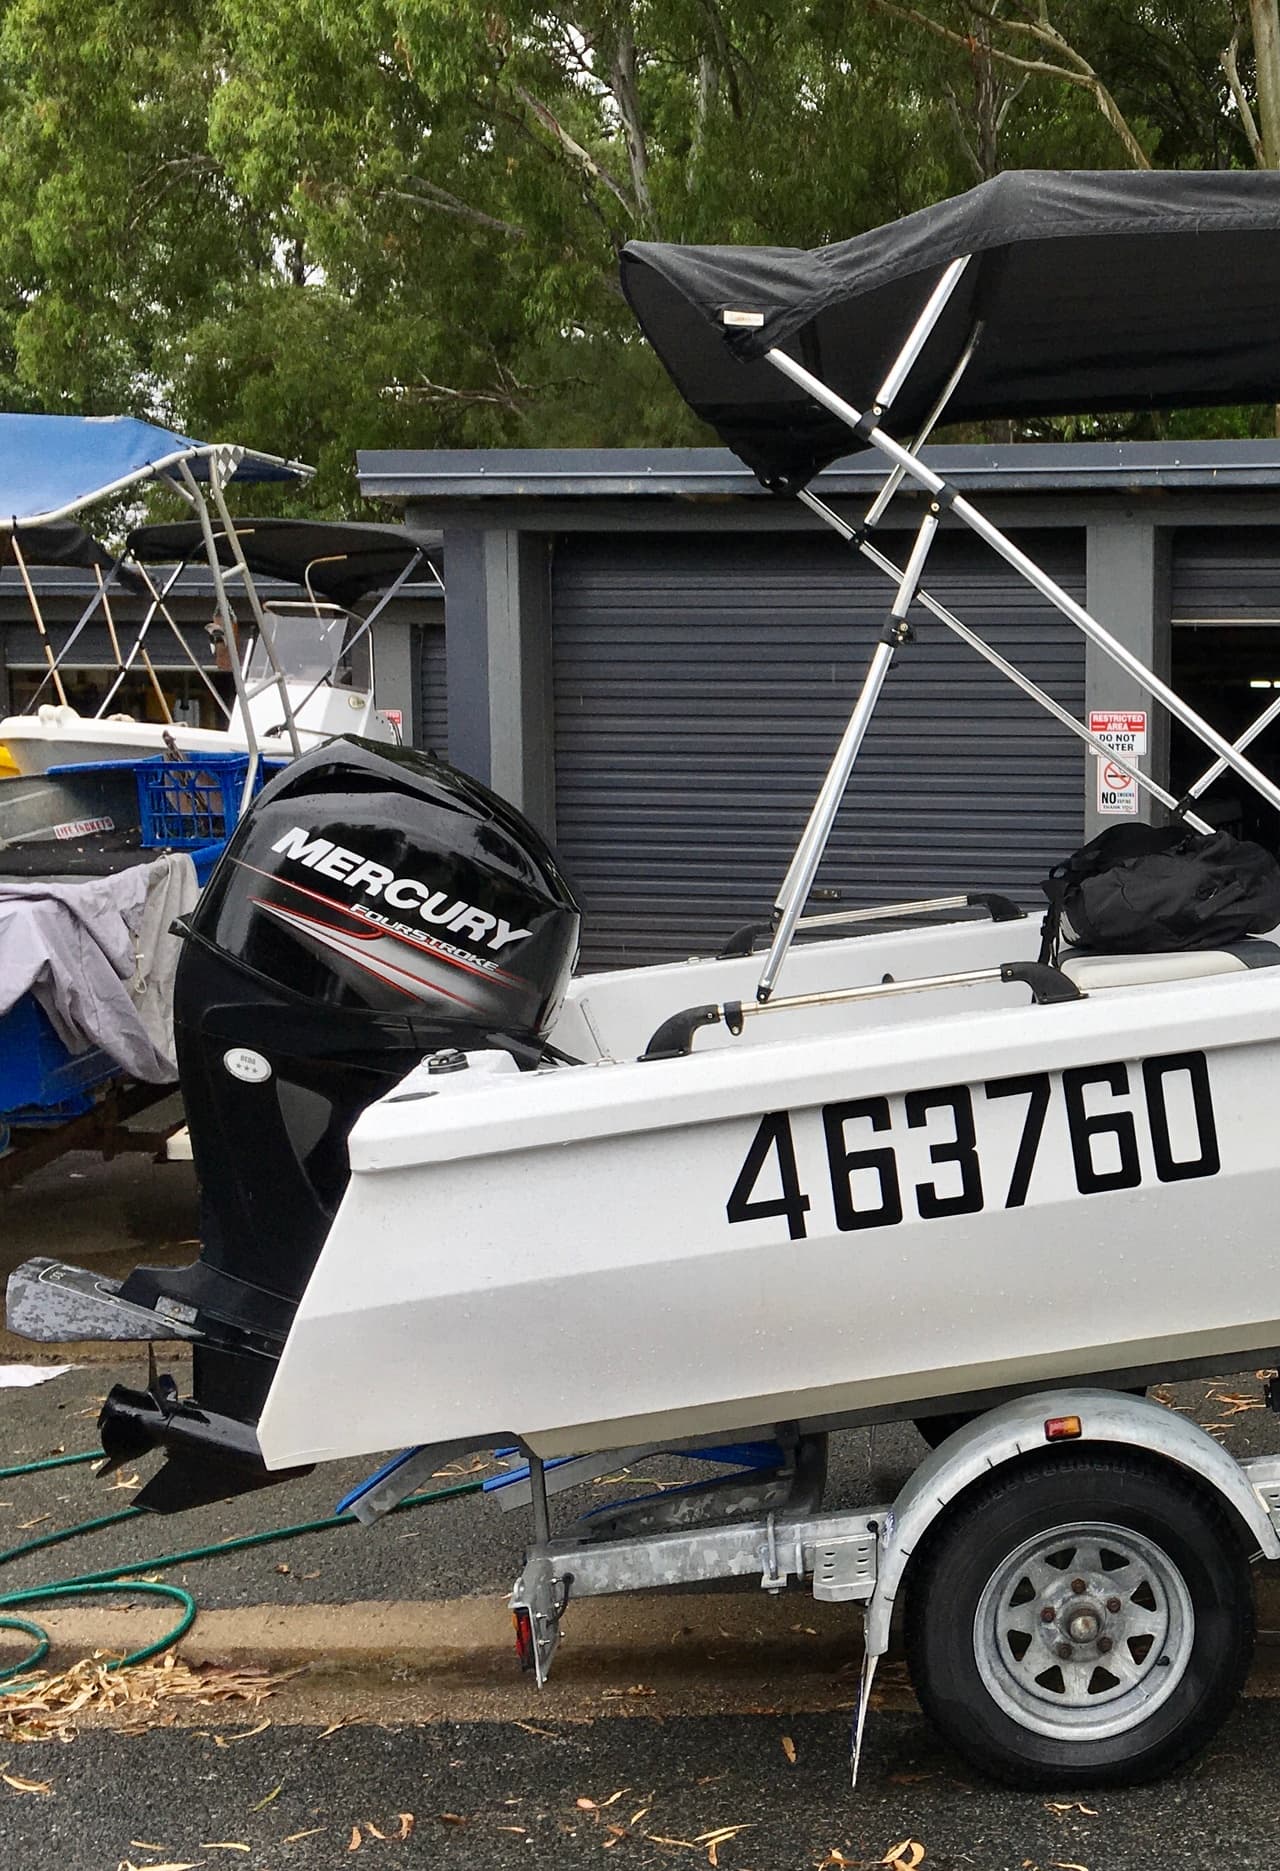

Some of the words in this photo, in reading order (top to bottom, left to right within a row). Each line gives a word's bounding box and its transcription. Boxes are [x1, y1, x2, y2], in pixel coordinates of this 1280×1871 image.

[1093, 714, 1143, 722] RESTRICTED
[1107, 723, 1129, 731] AREA
[1099, 734, 1113, 742] DO
[1116, 734, 1136, 742] NOT
[1101, 792, 1117, 804] NO
[271, 827, 533, 950] MERCURY
[350, 903, 499, 972] FOURSTROKE
[726, 1051, 1221, 1240] 463760
